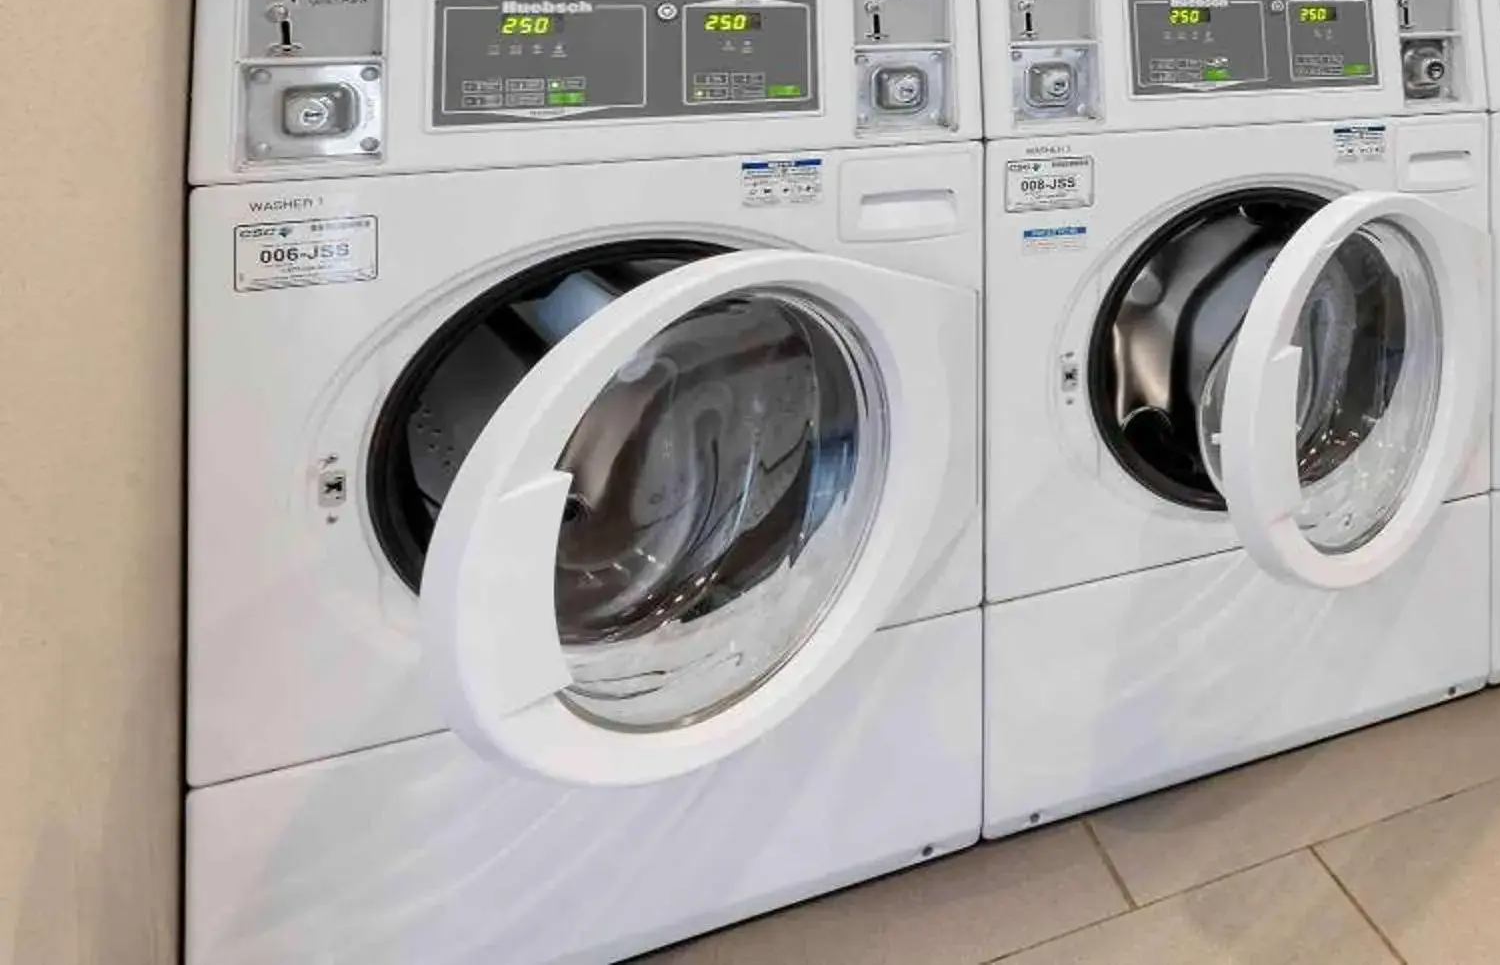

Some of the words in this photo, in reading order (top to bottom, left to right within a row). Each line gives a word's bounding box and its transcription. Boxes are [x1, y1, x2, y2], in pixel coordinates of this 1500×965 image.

[502, 0, 593, 14] Huebsch
[703, 13, 748, 32] 250
[1169, 9, 1201, 24] 250
[1299, 8, 1328, 22] 250
[501, 17, 550, 35] 250
[250, 198, 313, 212] WASHER
[260, 242, 350, 264] 006-JSS
